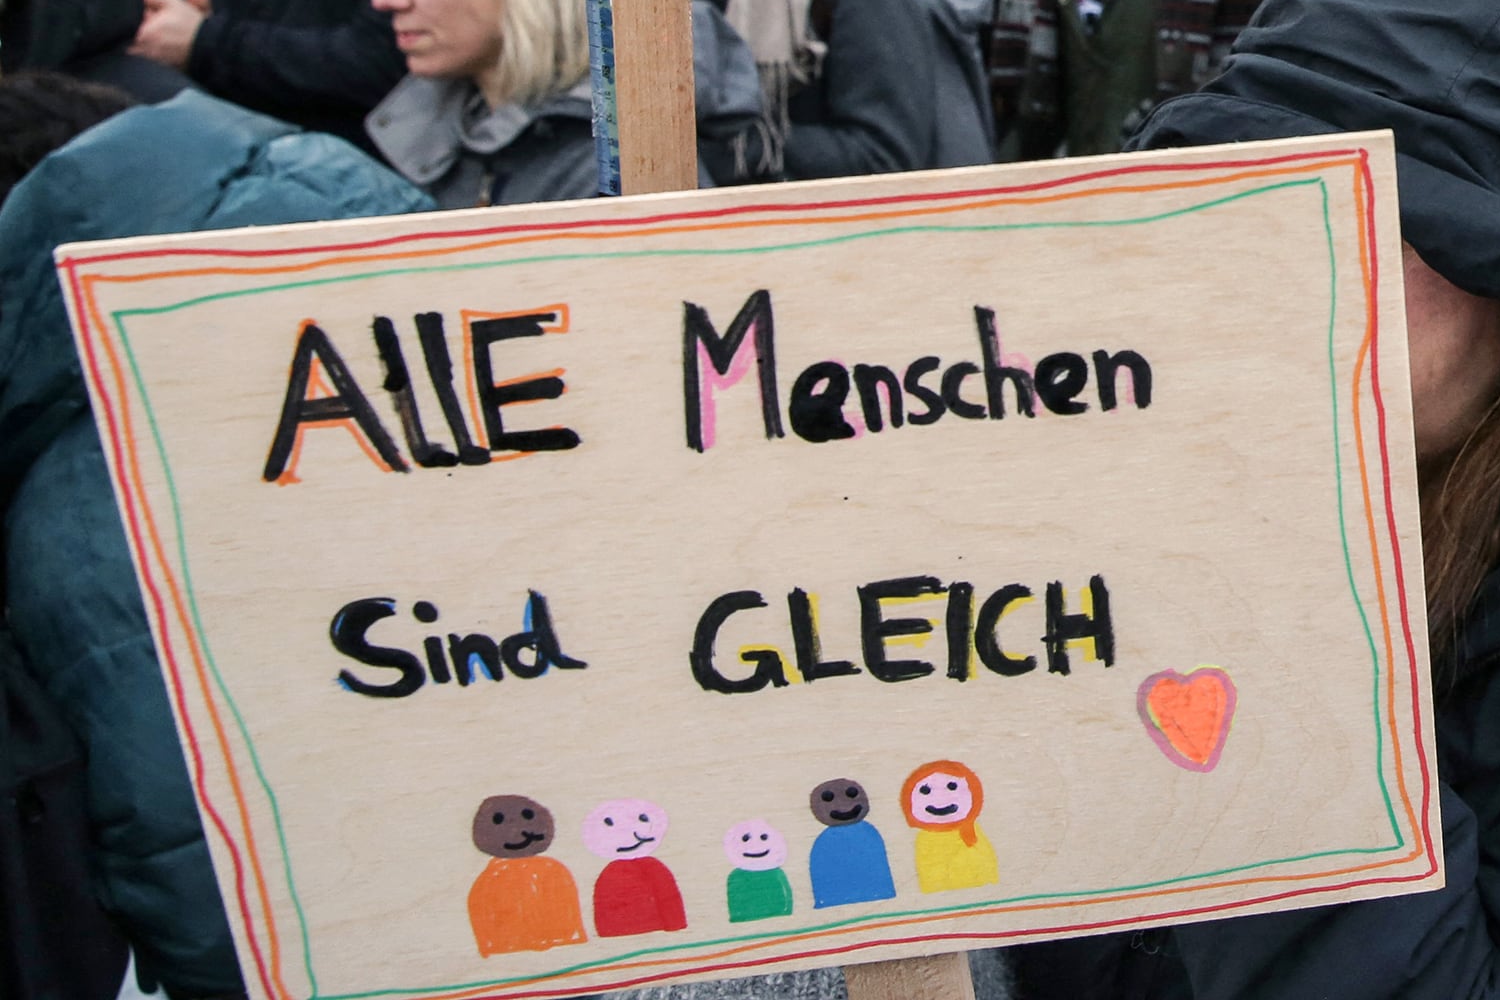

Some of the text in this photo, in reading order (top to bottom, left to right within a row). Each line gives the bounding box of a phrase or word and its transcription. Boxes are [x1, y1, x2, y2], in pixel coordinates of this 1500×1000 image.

[681, 288, 1153, 455] Menschen
[330, 573, 1116, 699] Sind GLEICH
